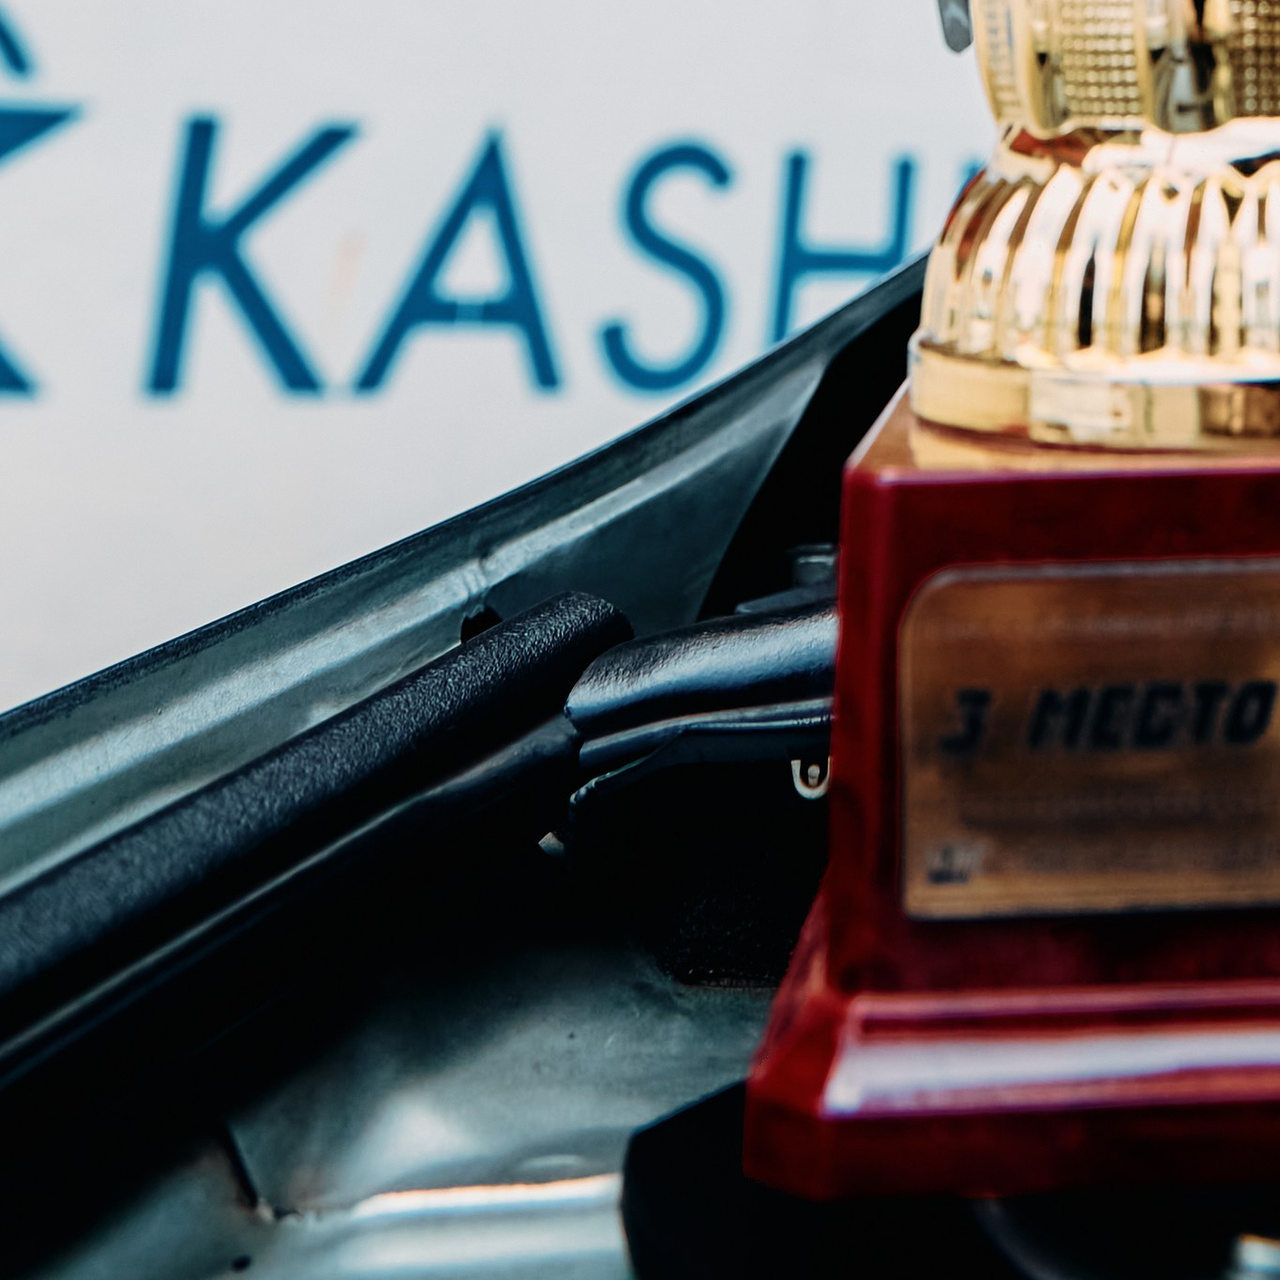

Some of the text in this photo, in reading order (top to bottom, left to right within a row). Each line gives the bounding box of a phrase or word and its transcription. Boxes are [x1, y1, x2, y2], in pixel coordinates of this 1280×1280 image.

[141, 111, 984, 399] KASH
[940, 679, 1279, 754] 3 МЕСТО
